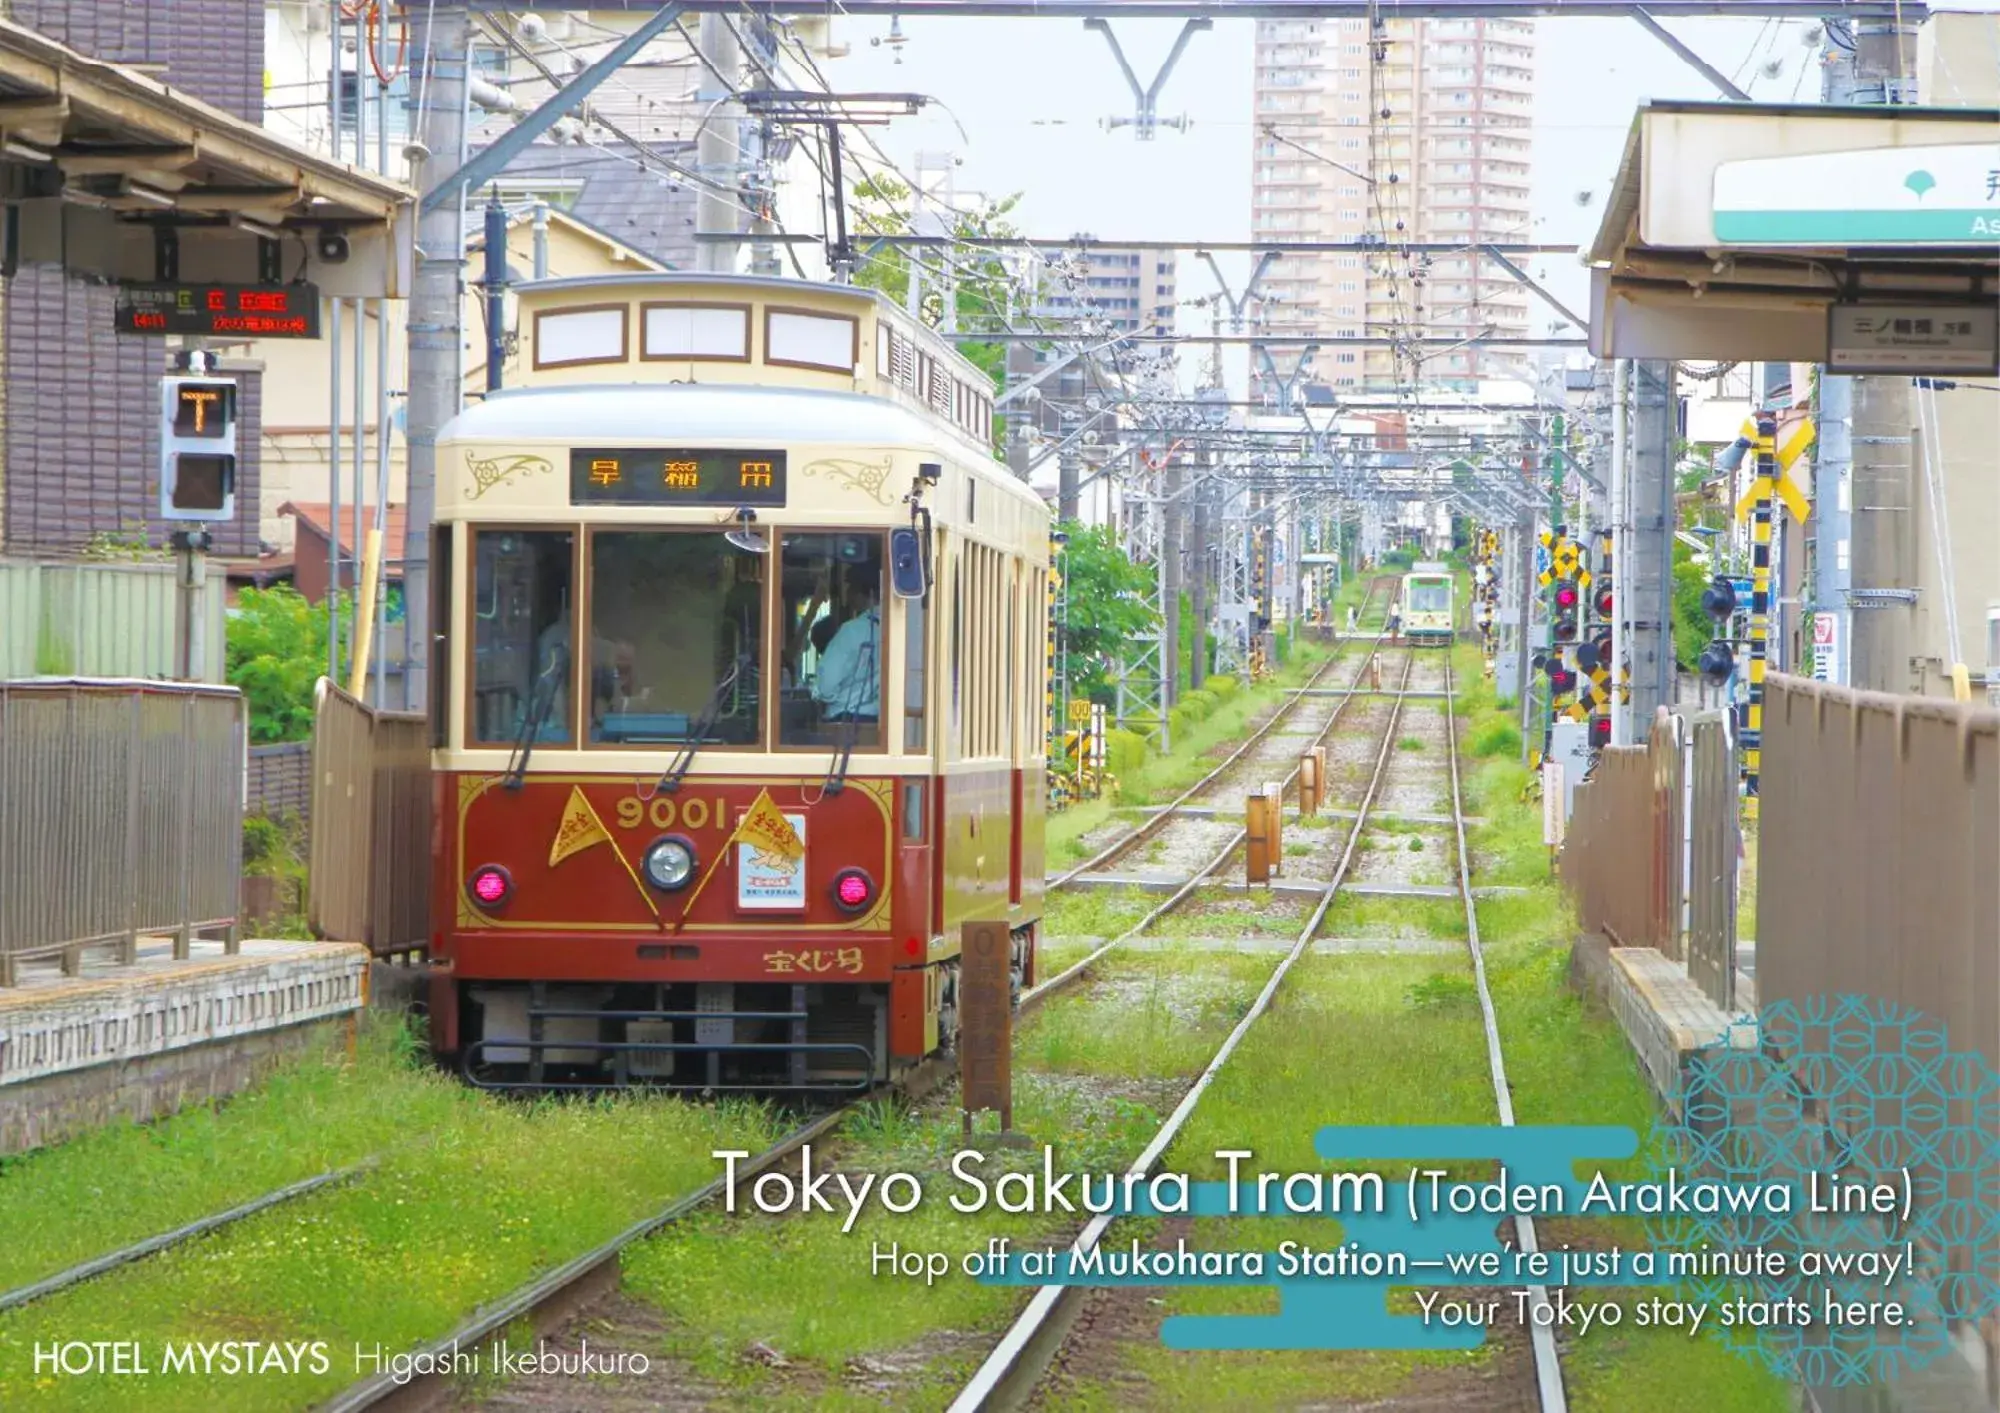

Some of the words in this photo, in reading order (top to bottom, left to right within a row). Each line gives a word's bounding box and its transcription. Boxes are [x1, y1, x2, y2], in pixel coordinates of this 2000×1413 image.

[616, 796, 726, 830] 9001
[762, 946, 865, 975] 宝くじ号
